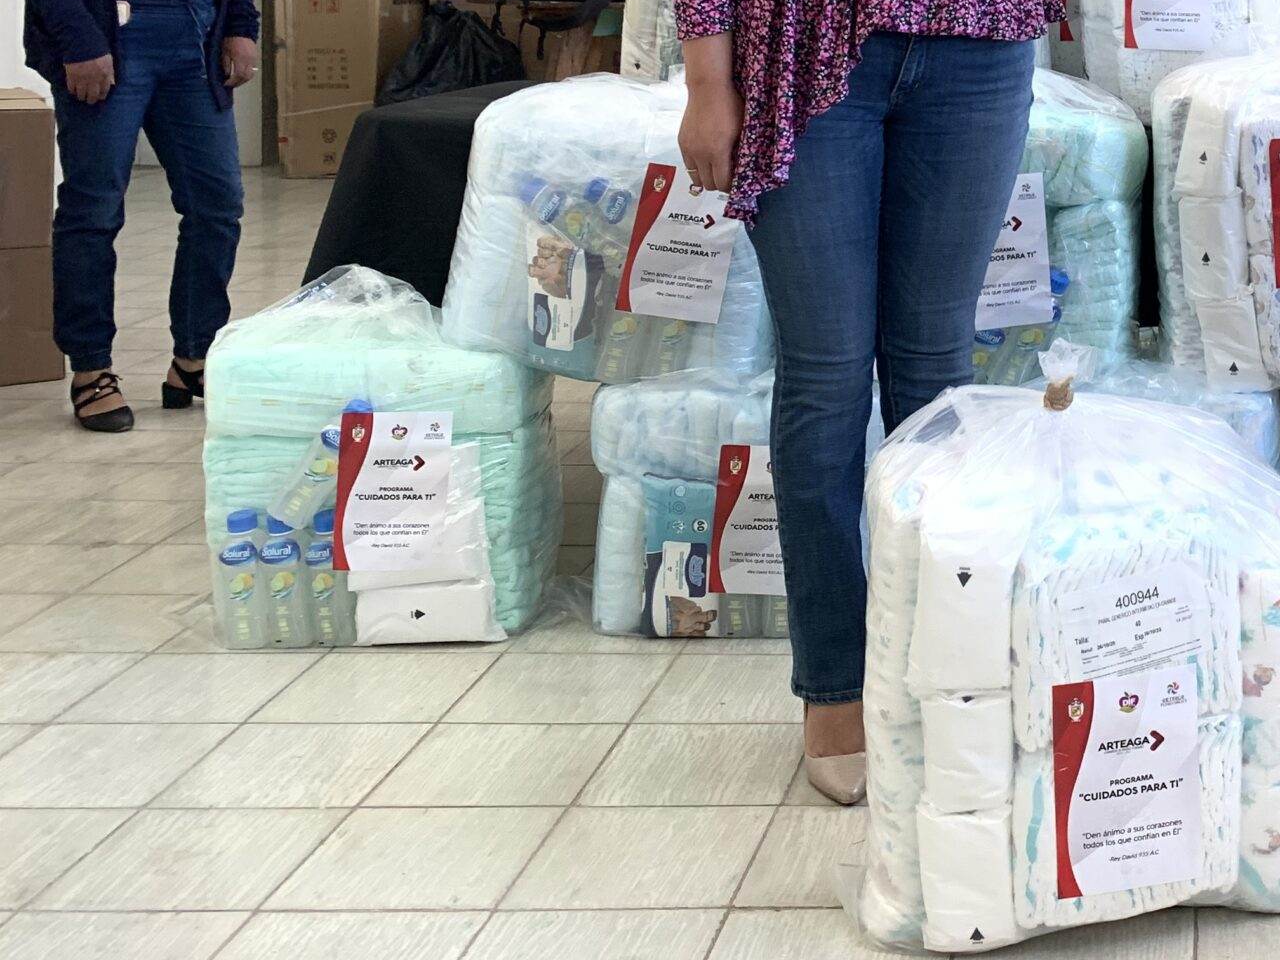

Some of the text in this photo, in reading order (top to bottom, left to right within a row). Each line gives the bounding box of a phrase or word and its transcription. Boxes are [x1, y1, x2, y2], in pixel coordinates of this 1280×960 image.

[668, 213, 705, 223] ARTEAGA
[1115, 586, 1159, 609] 400944
[1098, 736, 1150, 752] ARTEAGA
[1110, 774, 1154, 786] PROGRAMA
[1141, 782, 1167, 793] PARA
[1146, 819, 1183, 830] corazones
[1083, 842, 1104, 850] todos
